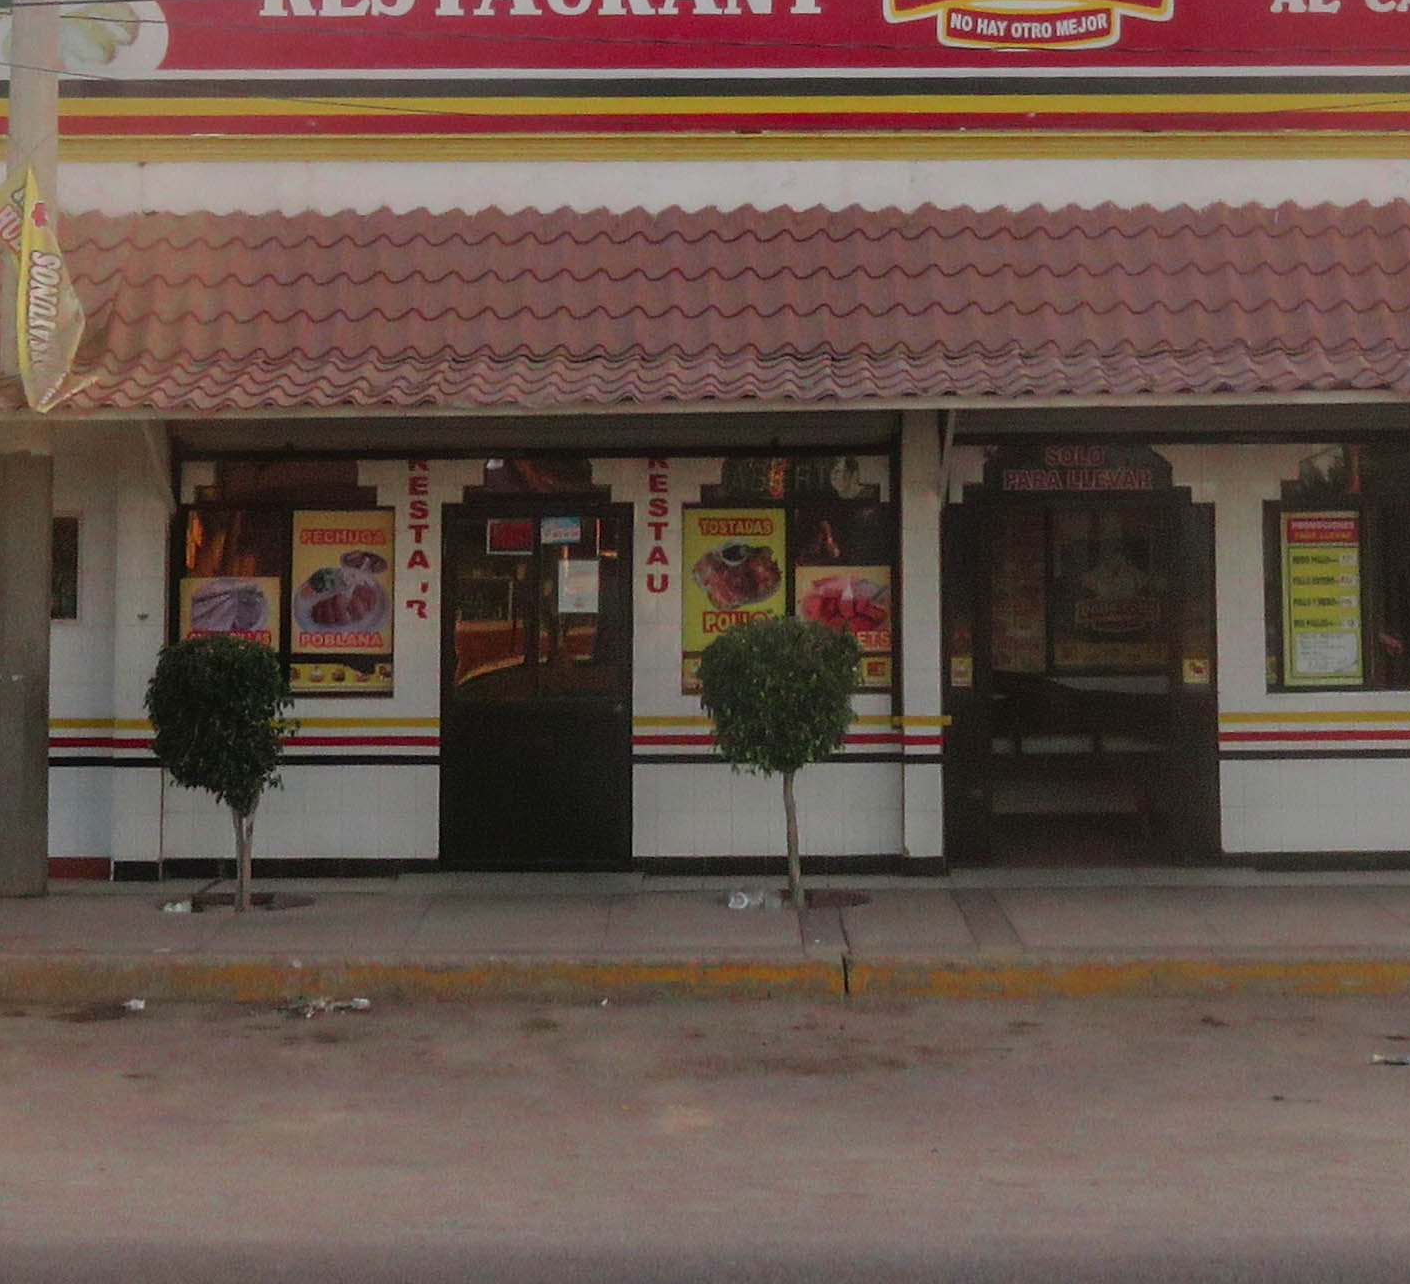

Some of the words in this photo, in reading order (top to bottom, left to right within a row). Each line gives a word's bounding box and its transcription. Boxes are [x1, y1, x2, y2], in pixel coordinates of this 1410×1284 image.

[950, 12, 973, 32] NO
[976, 16, 1007, 36] HAY
[1011, 18, 1052, 39] OTRO
[1056, 13, 1108, 36] MEJOR
[1002, 468, 1063, 491] PARA
[1066, 468, 1154, 491] LLEVAR
[698, 517, 774, 536] TOSTADAS
[300, 528, 387, 545] PECHUGA
[299, 631, 384, 649] POBLANA
